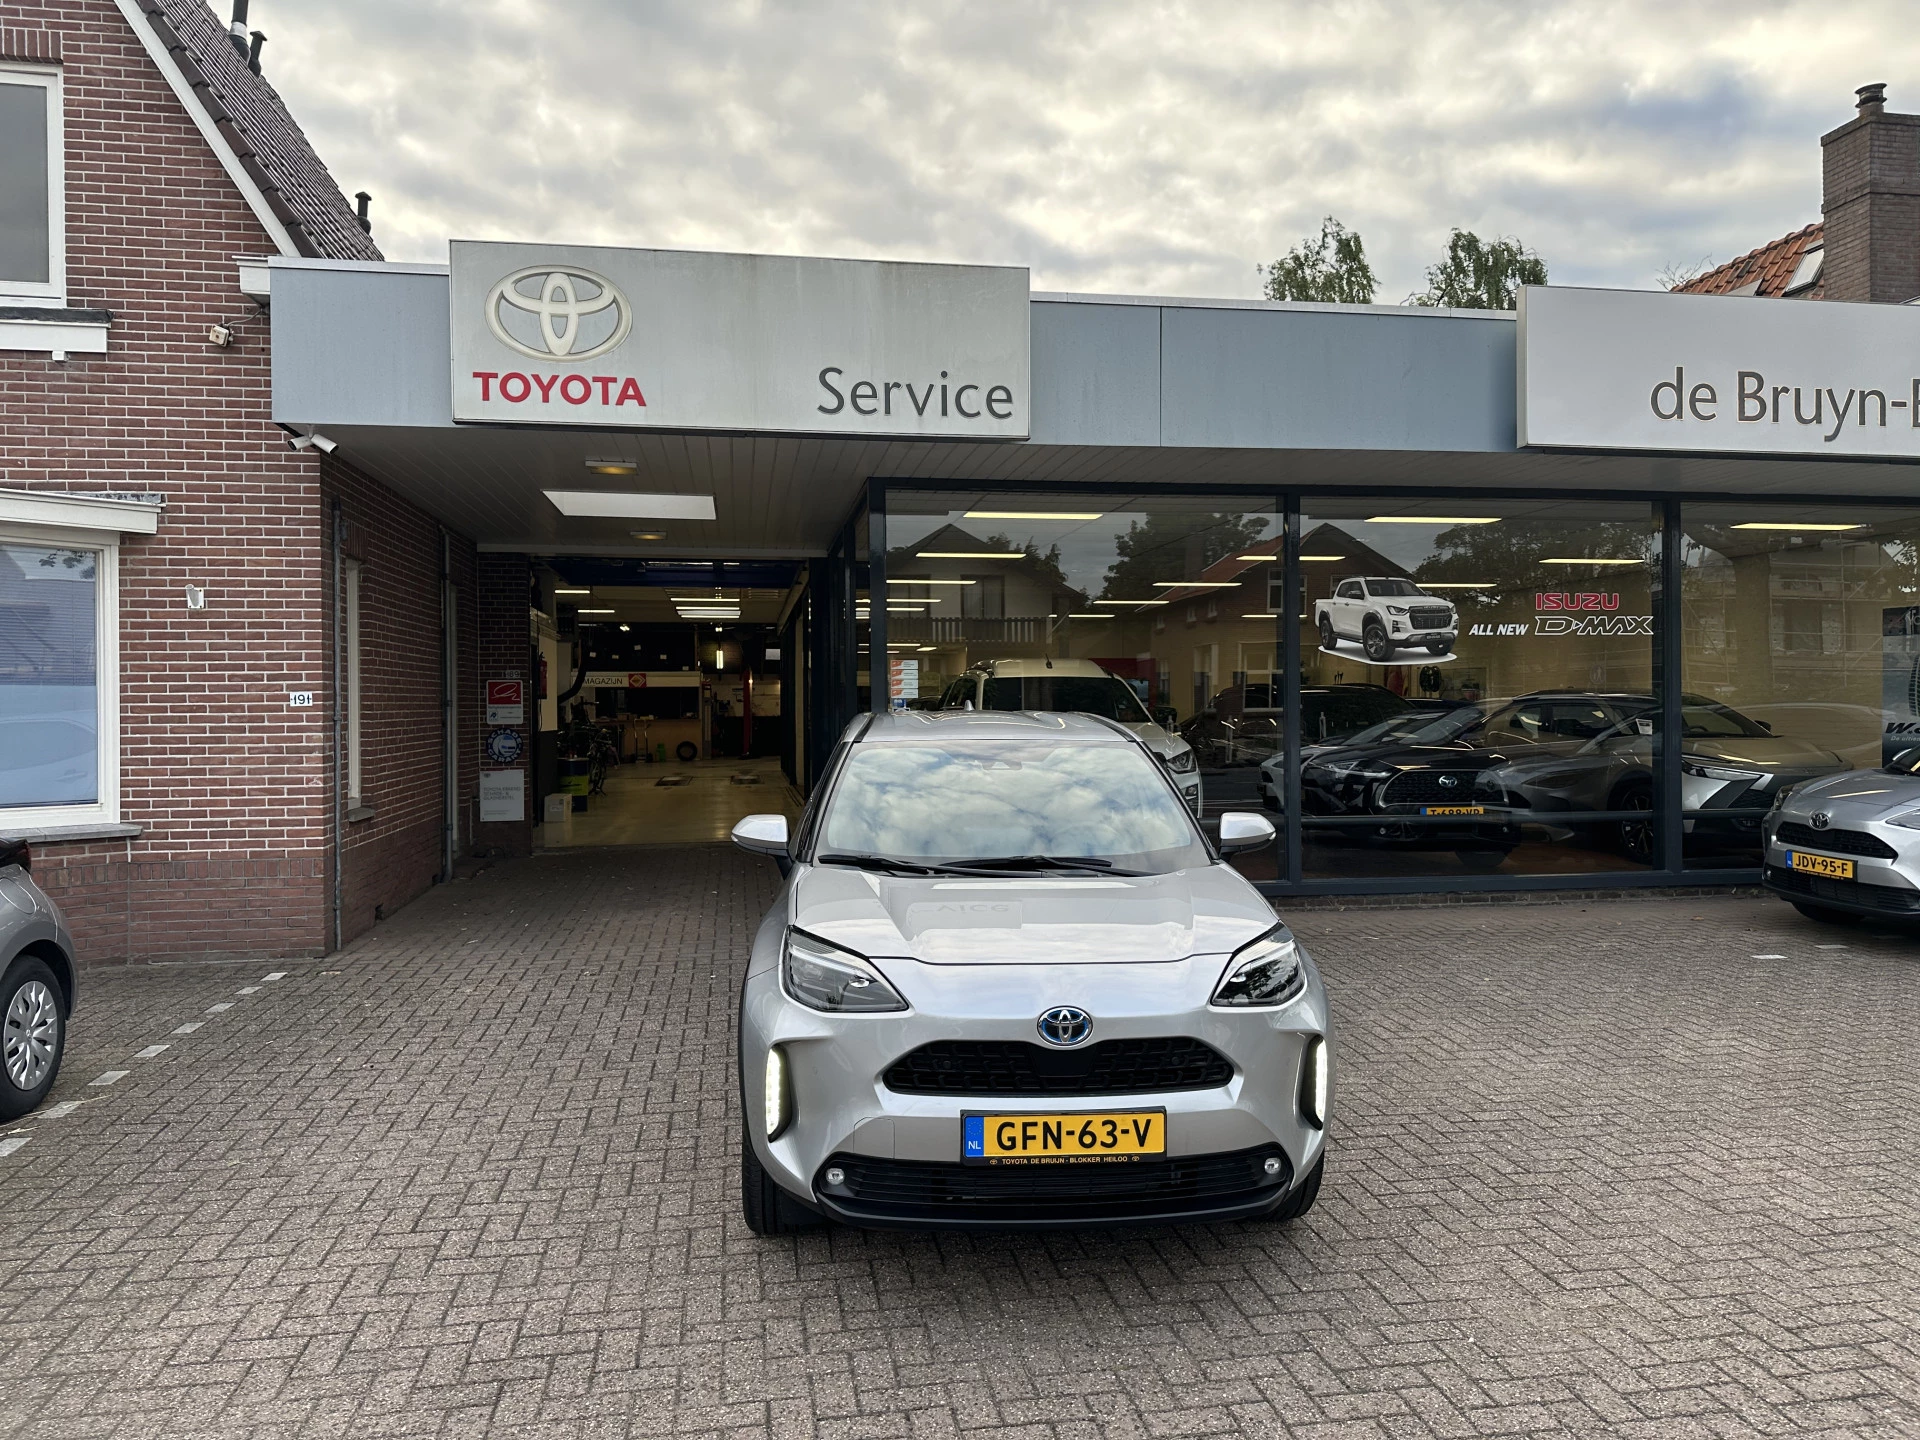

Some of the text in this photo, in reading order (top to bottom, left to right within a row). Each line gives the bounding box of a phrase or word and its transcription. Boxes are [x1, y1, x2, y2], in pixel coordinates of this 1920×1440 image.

[472, 371, 647, 407] TOYOTA
[817, 366, 1014, 420] Service
[1649, 366, 1920, 443] de Bruyn-
[1535, 592, 1620, 611] ISUZU
[1468, 624, 1494, 636] ALL
[1496, 624, 1529, 636] NEW
[1795, 854, 1848, 875] JDV-95-F
[968, 1118, 1152, 1151] NL GFN-63-V
[1001, 1157, 1028, 1165] TOYOTA
[1040, 1156, 1065, 1164] BRUIJN
[1069, 1156, 1101, 1164] BLOKKER
